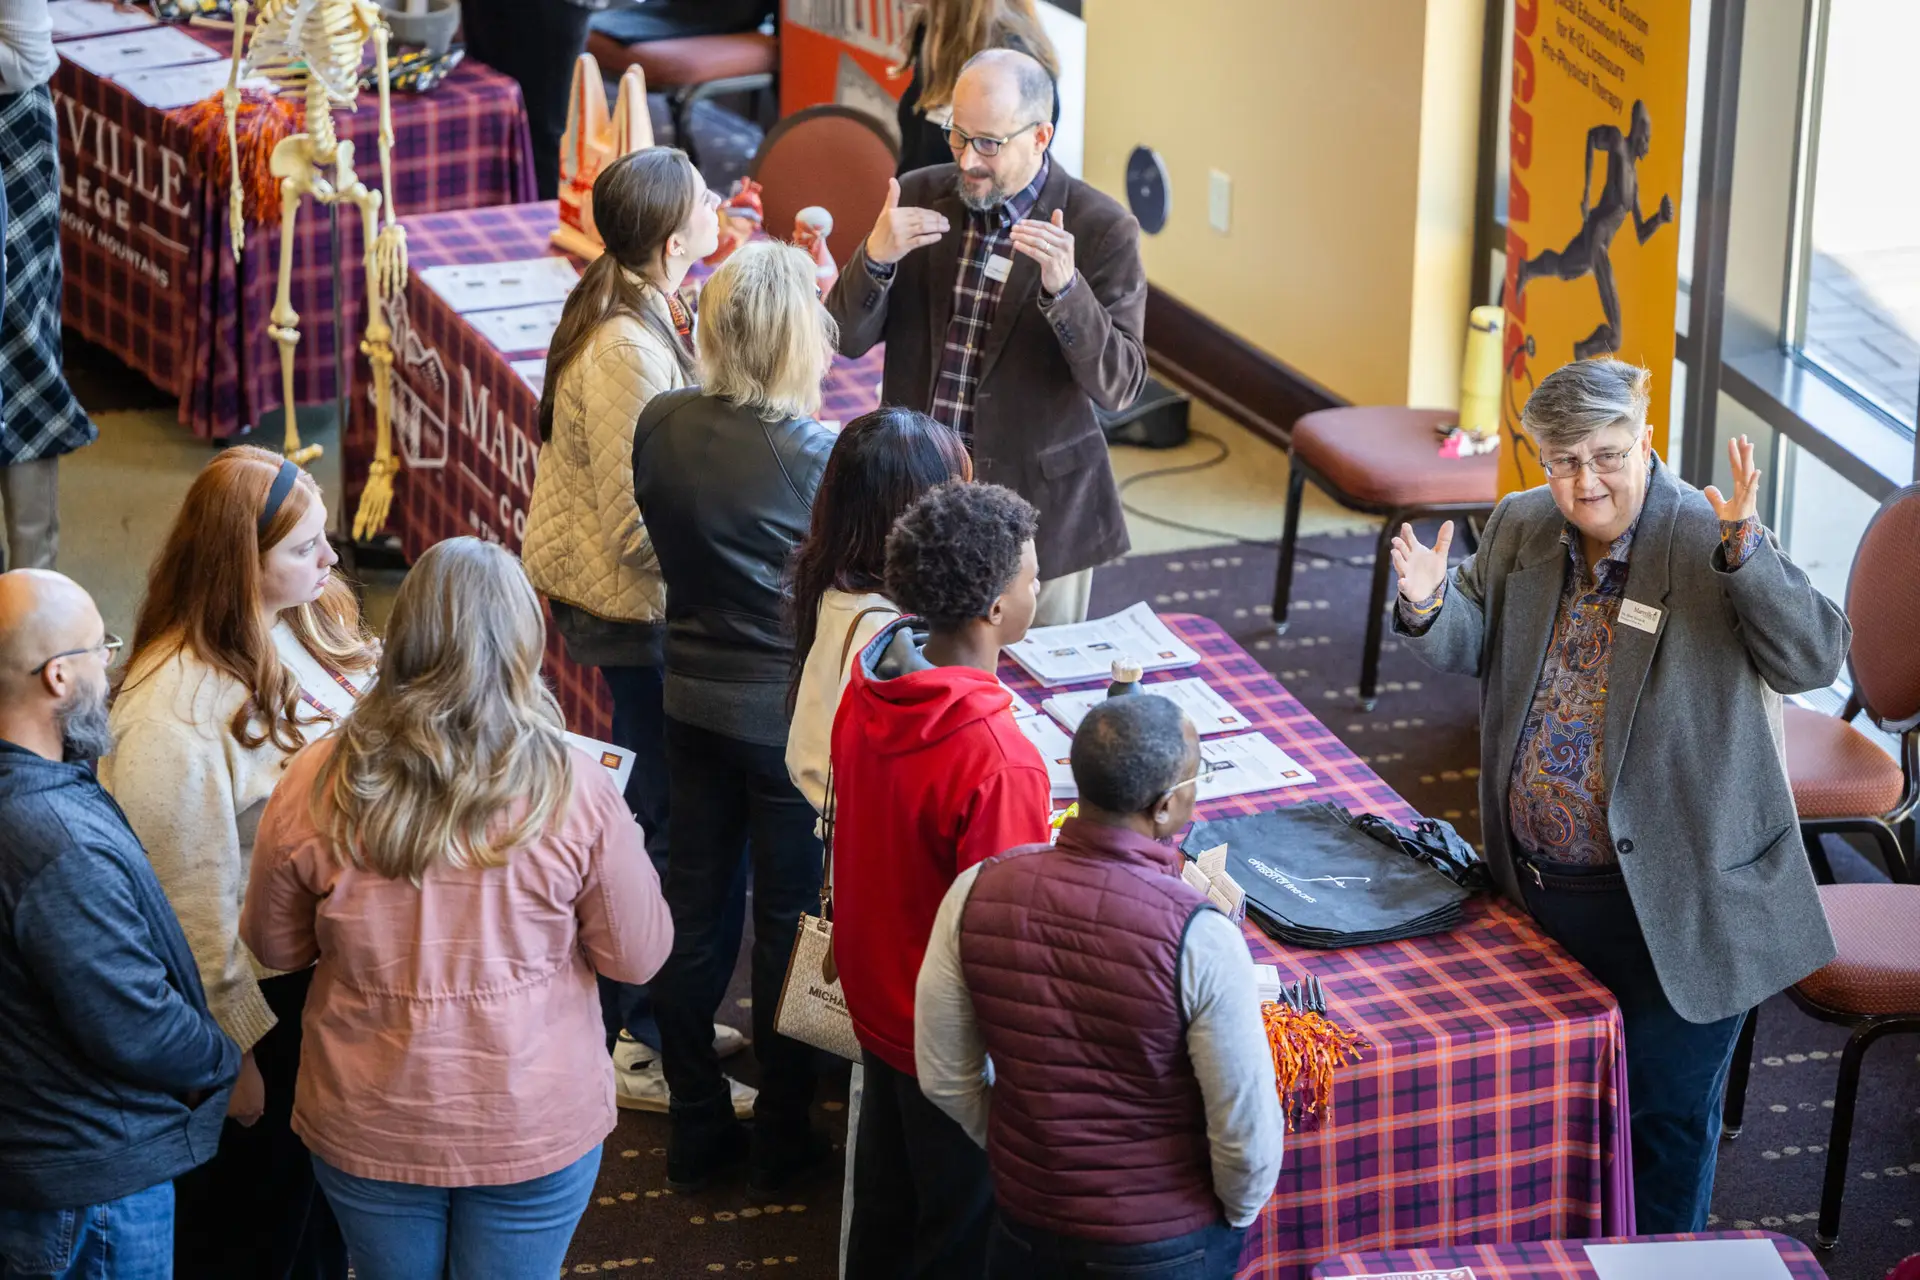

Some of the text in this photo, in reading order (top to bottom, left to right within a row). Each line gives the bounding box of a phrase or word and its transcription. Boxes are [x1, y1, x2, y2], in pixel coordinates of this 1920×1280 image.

[1555, 17, 1625, 82] for K-12 Licensure
[1591, 72, 1623, 116] Therapy
[53, 89, 191, 219] VILLE
[97, 229, 169, 288] MOUNTAINS
